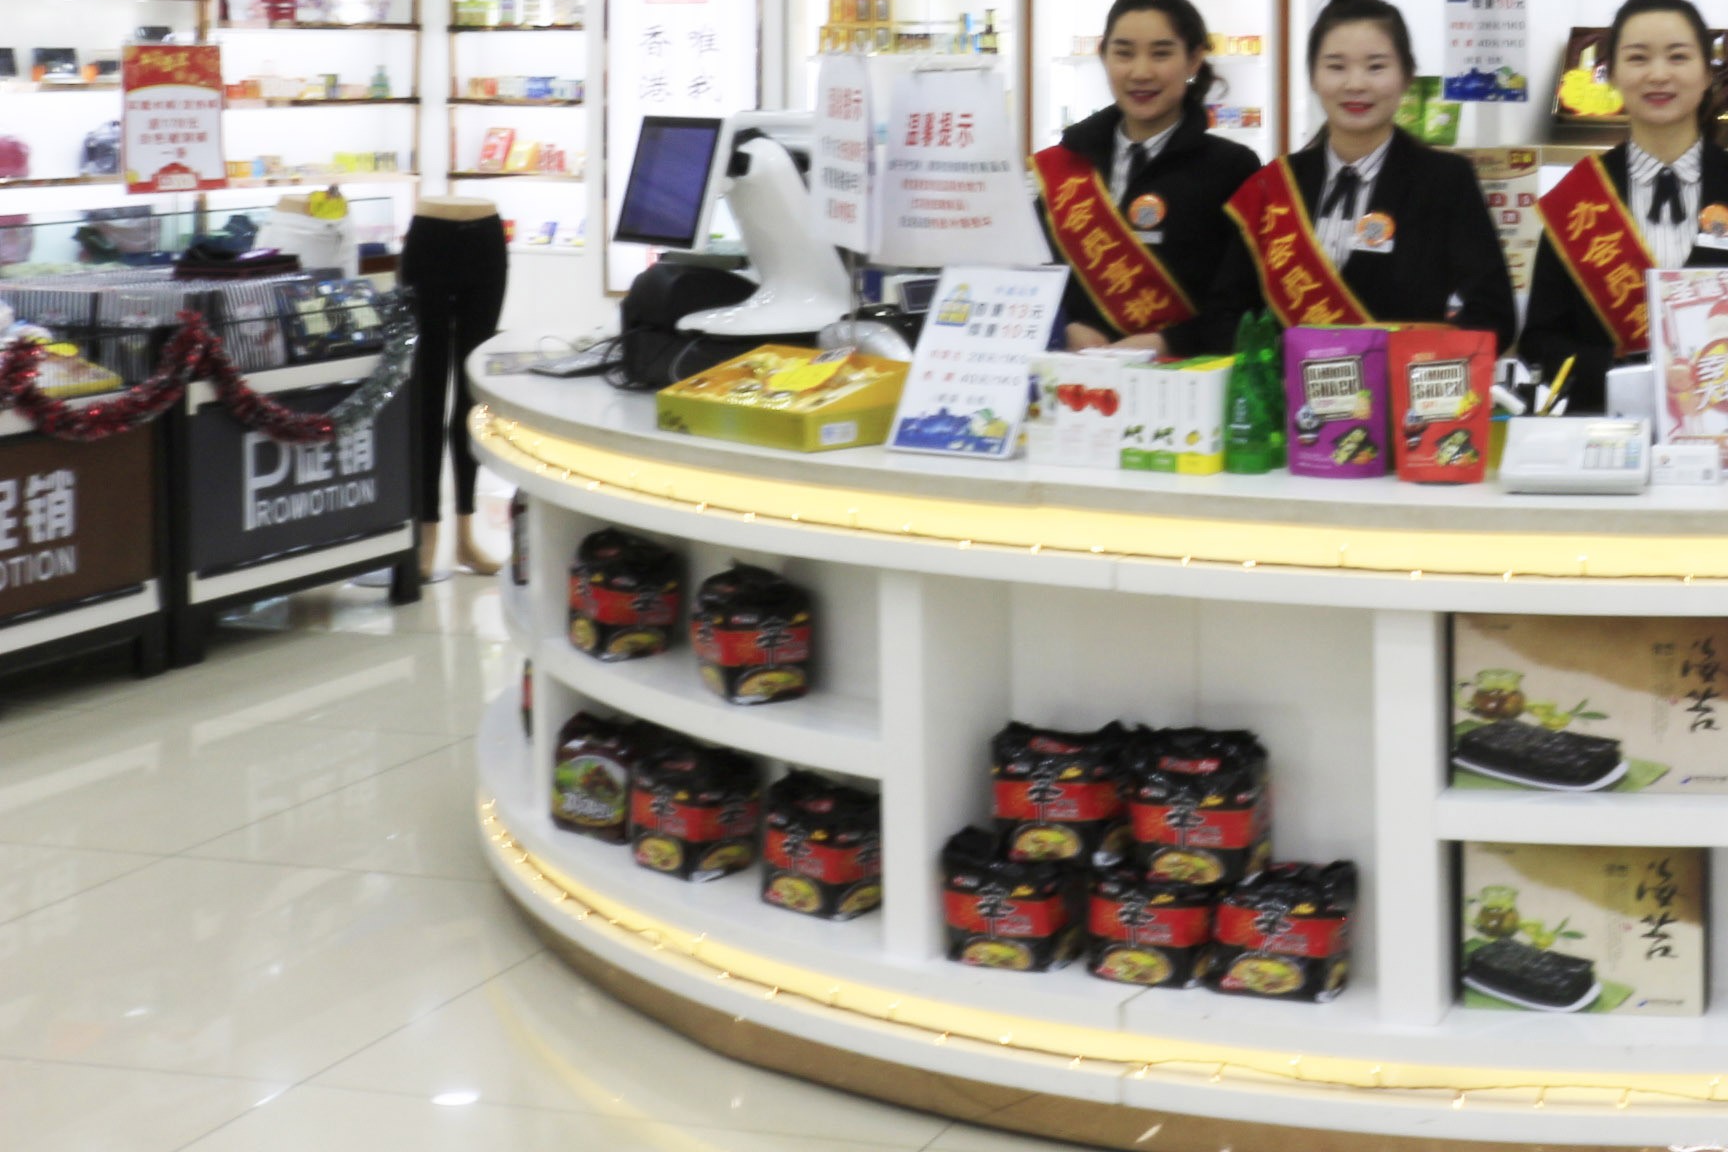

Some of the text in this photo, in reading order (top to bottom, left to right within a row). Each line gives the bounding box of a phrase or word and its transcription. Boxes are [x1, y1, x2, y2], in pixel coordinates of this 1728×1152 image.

[1053, 176, 1171, 330] 办会员享批
